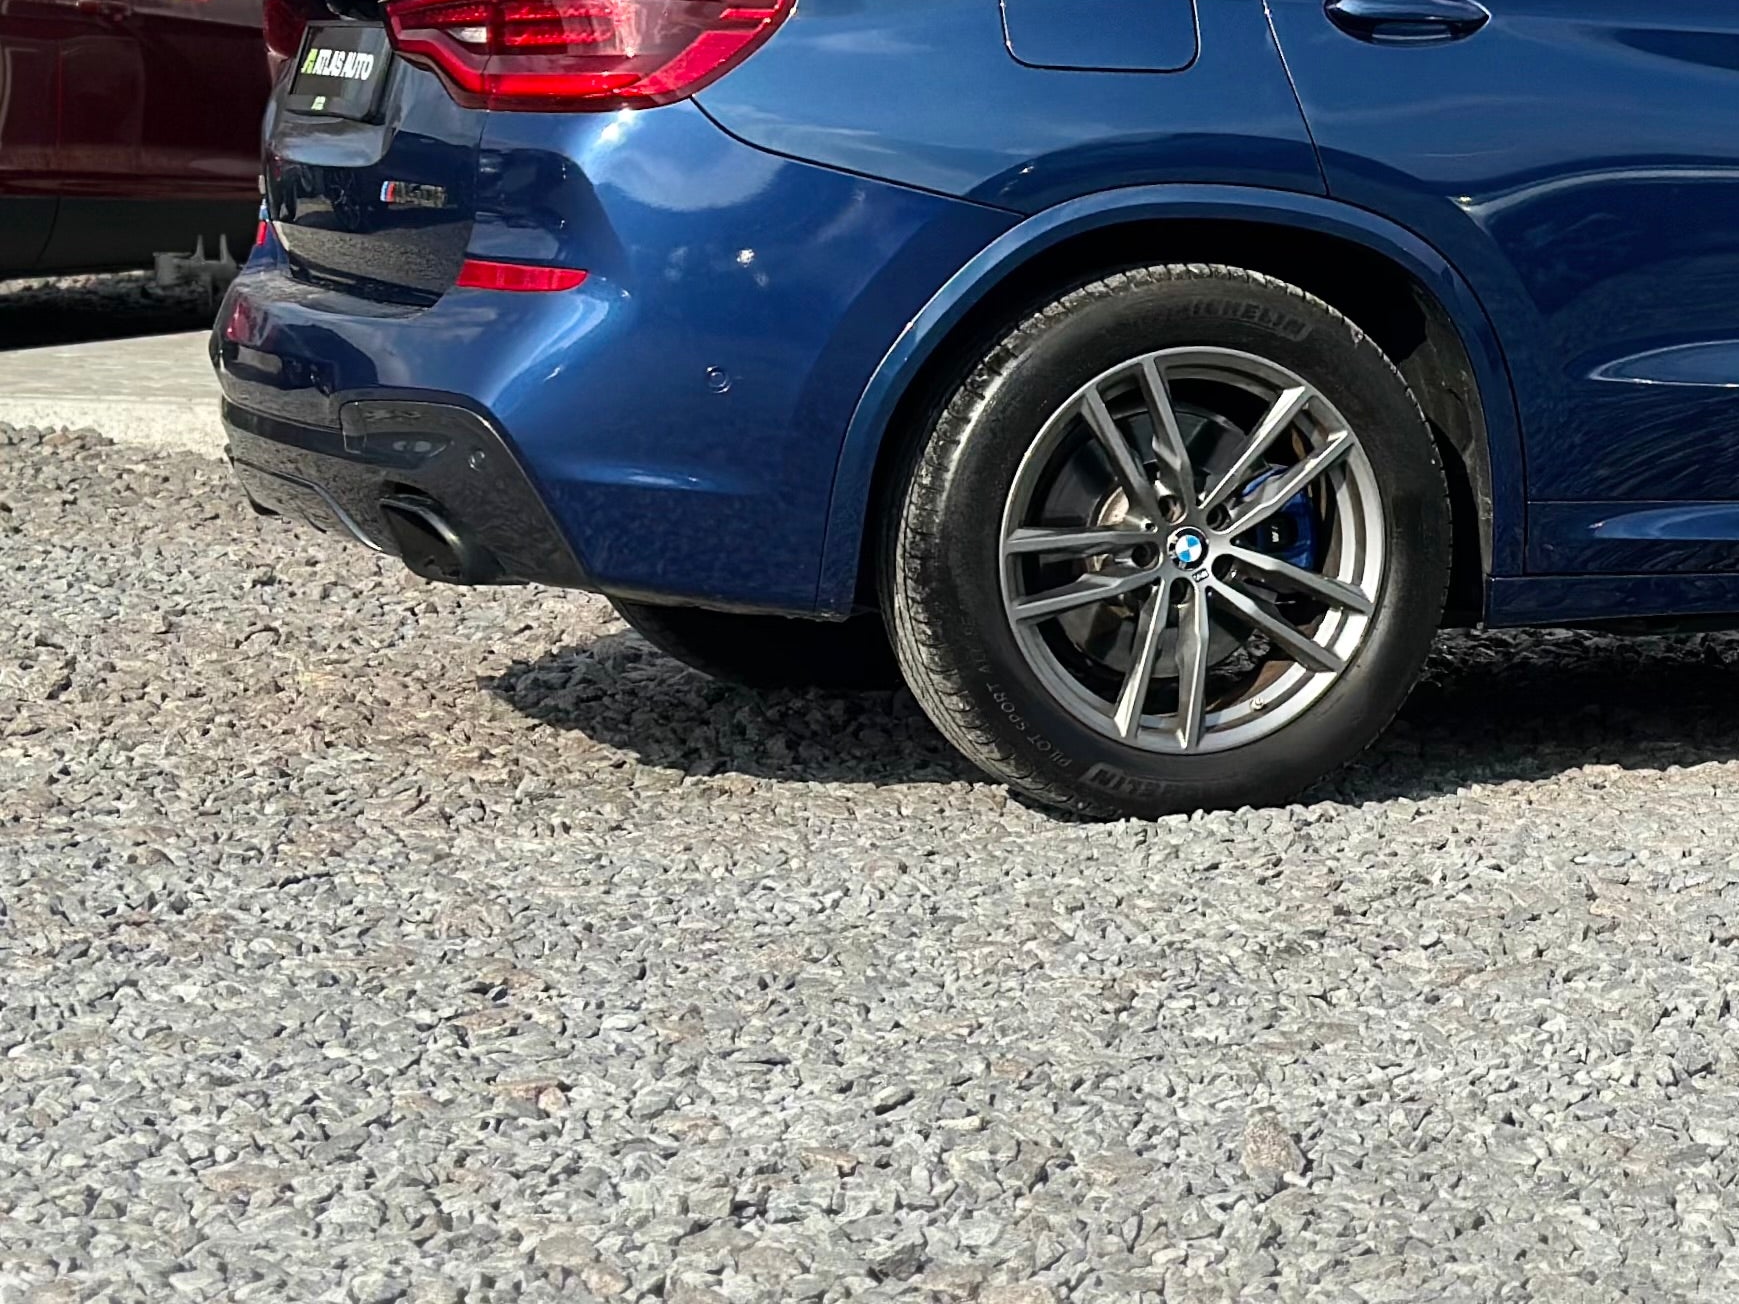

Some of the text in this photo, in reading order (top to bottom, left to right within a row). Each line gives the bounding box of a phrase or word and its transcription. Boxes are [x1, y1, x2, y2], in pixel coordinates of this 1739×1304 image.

[312, 49, 374, 80] ATLAS AUTO
[986, 681, 1030, 734] SPORT
